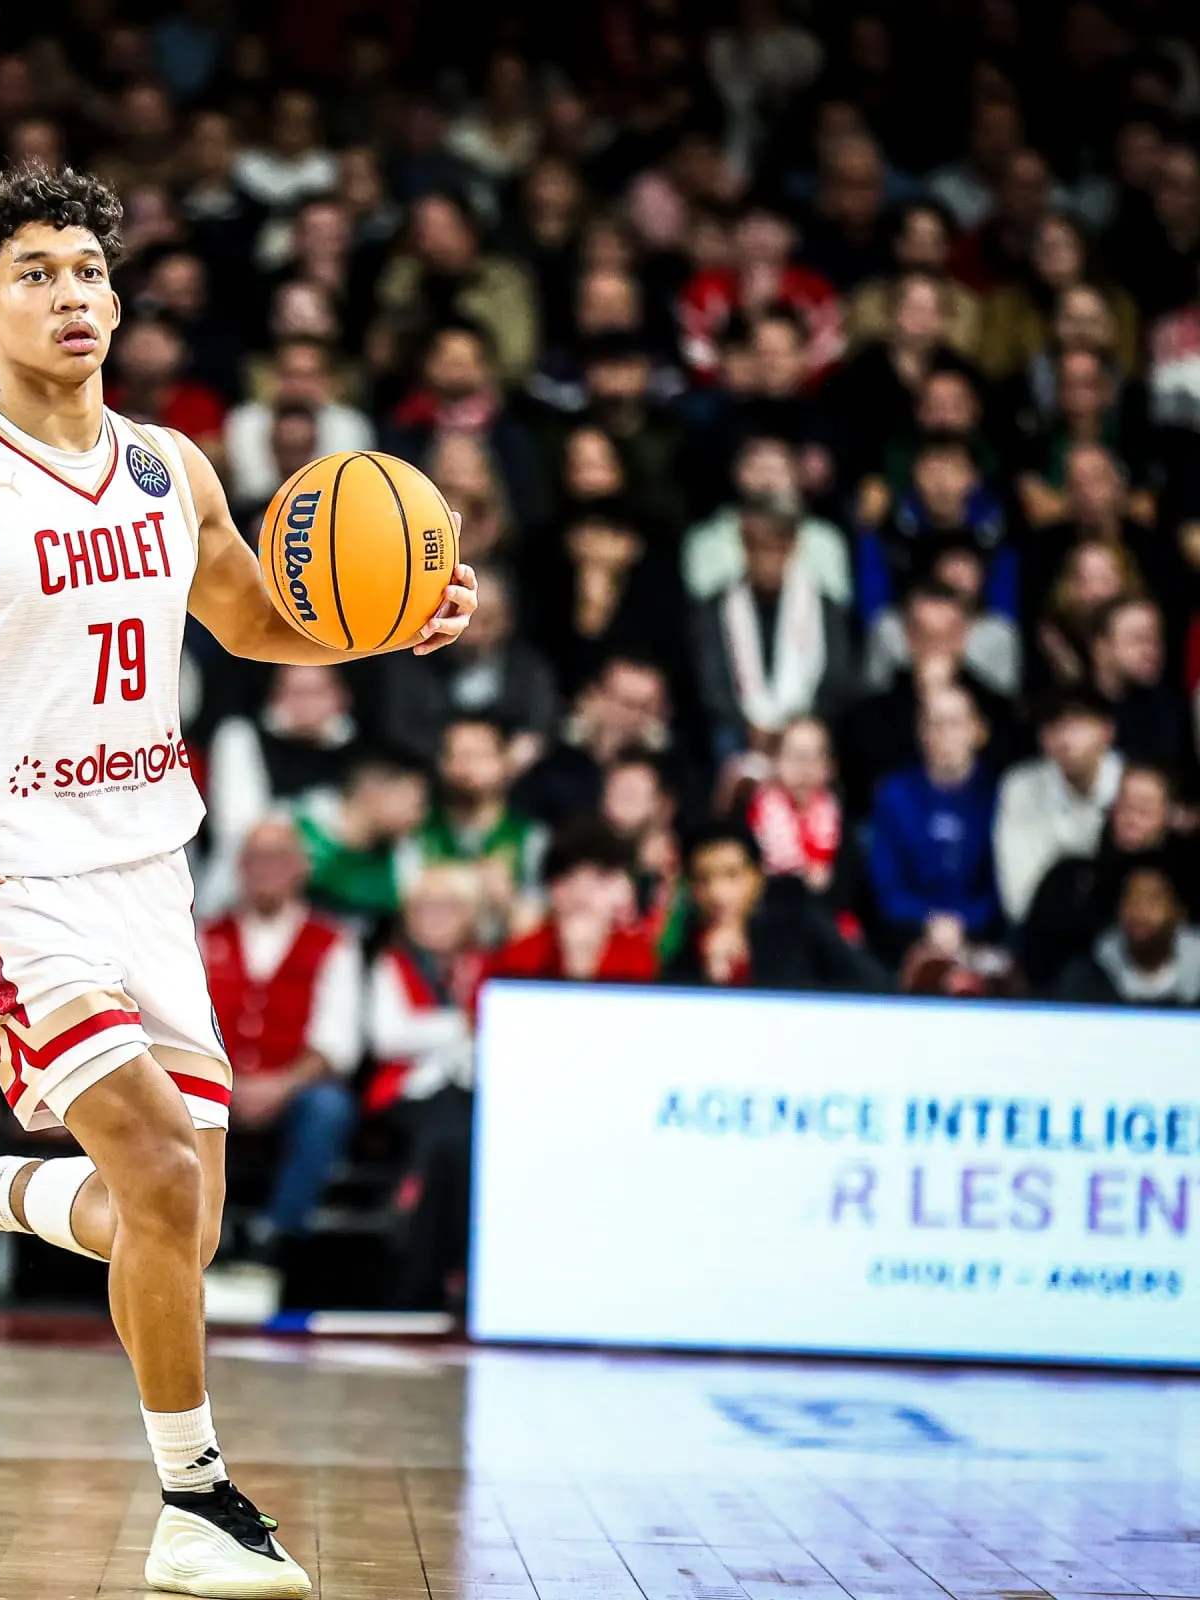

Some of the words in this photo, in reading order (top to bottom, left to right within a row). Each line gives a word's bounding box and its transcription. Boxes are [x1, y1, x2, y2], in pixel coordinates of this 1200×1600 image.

[34, 511, 171, 596] CHOLET
[285, 490, 322, 622] Wilson
[423, 528, 439, 572] FIBA
[437, 528, 445, 570] APPROVED
[87, 617, 146, 705] 79
[54, 790, 77, 799] Votre
[104, 784, 121, 793] notre
[654, 1087, 884, 1144] AGENCE
[905, 1095, 1200, 1156] INTELLIGE
[909, 1163, 1055, 1233] LES
[1086, 1167, 1200, 1238] EN
